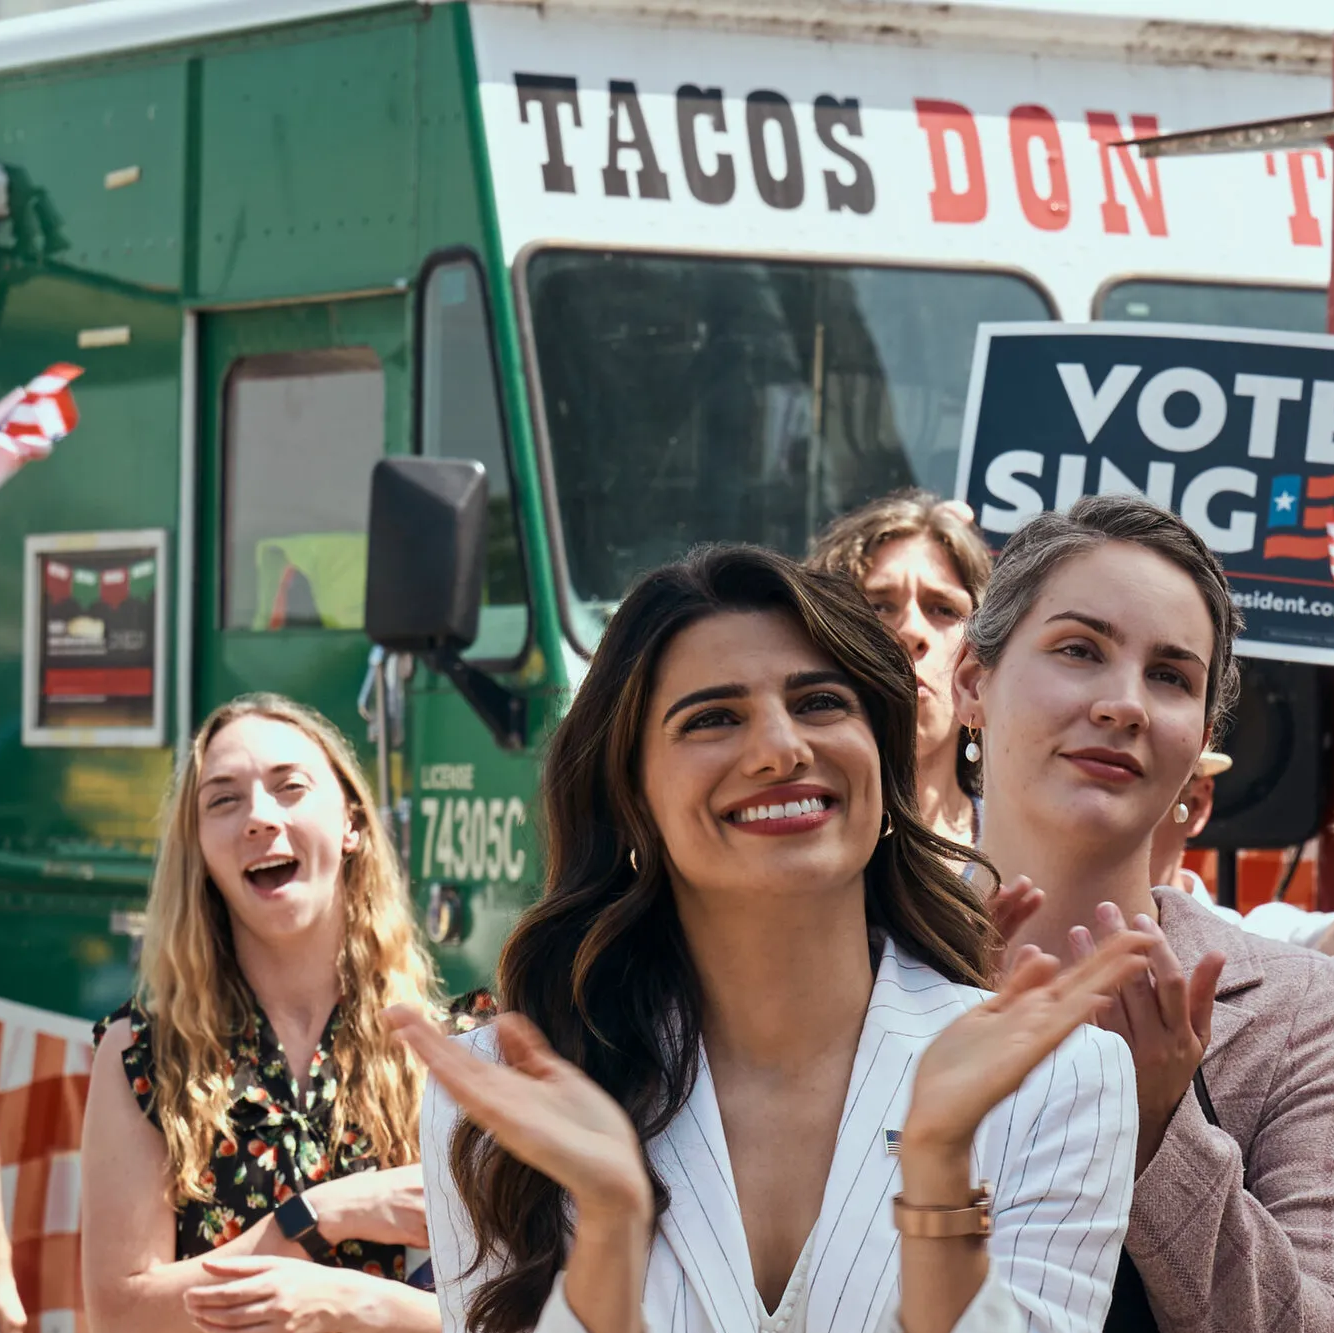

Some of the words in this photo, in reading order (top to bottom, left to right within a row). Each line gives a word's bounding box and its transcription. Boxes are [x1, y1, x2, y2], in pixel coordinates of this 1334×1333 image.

[512, 73, 876, 215] TACOS
[912, 97, 1170, 237] DON
[421, 797, 526, 881] 74305C
